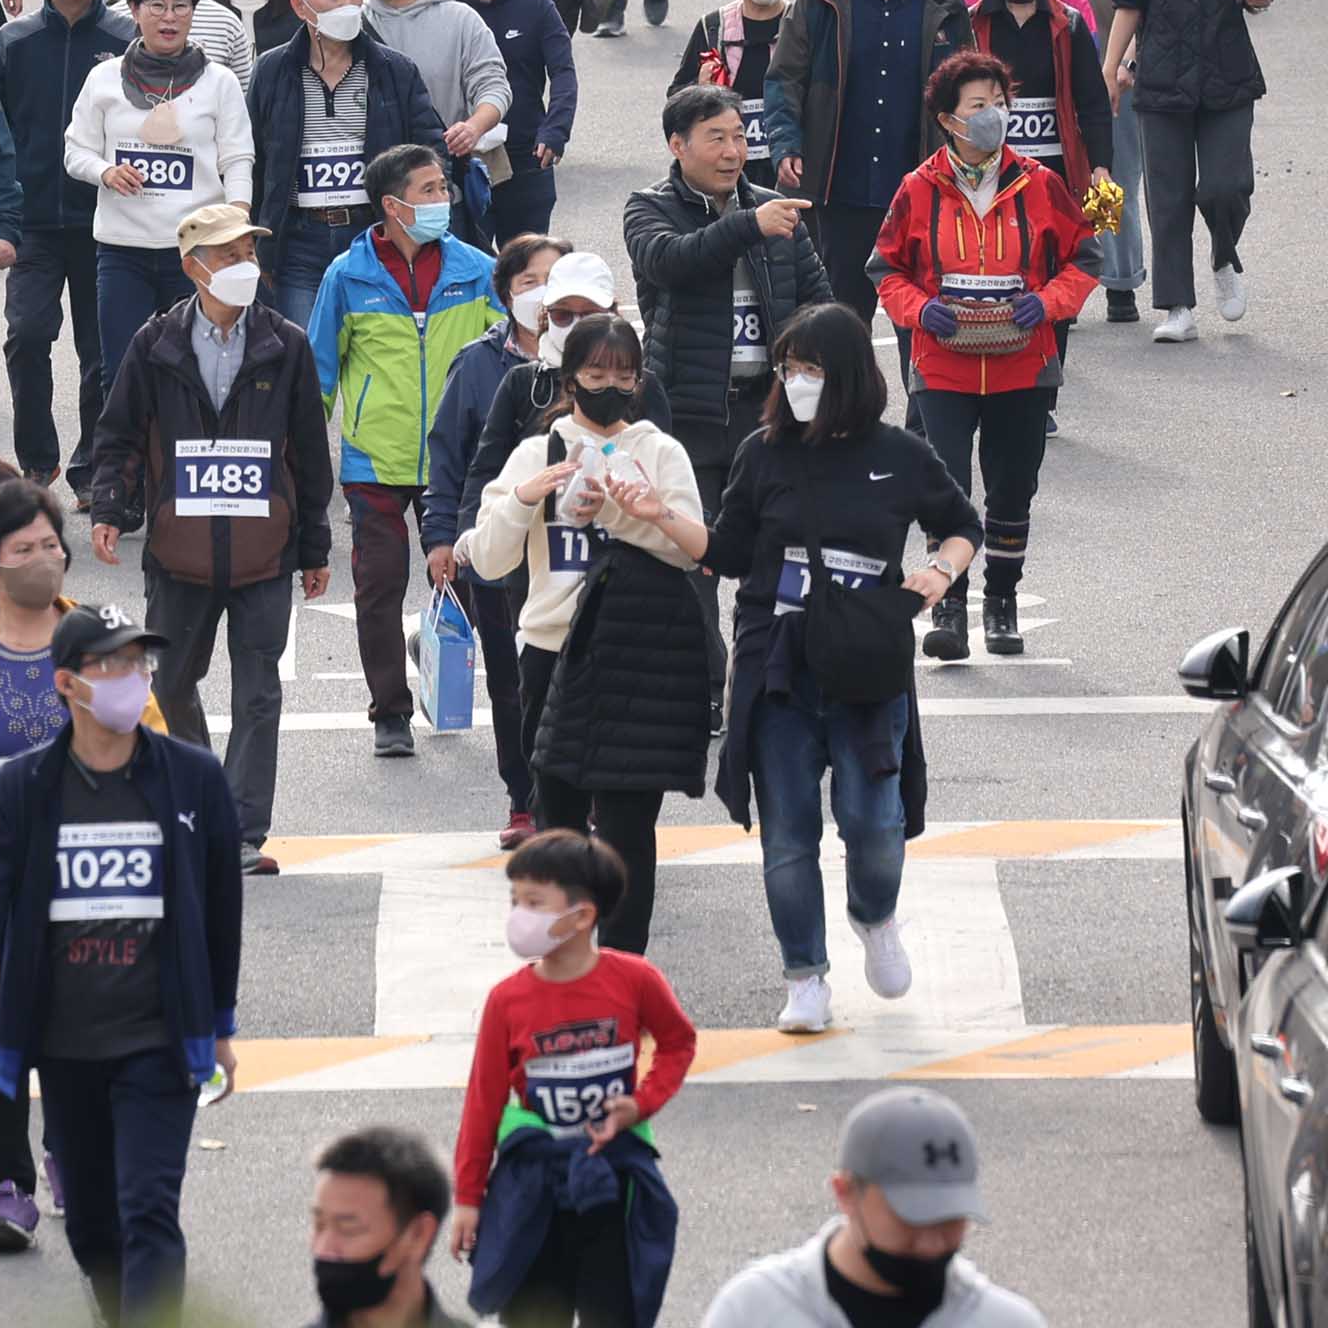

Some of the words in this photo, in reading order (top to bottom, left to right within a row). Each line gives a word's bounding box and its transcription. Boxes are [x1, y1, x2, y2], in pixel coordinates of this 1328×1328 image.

[121, 157, 187, 186] 380
[304, 161, 367, 188] 1292
[179, 445, 199, 454] 2022
[216, 445, 269, 455] 구민건강걷기대회
[185, 464, 263, 494] 1483
[787, 549, 808, 559] 202
[56, 848, 153, 889] 1023
[68, 938, 136, 966] STYLE
